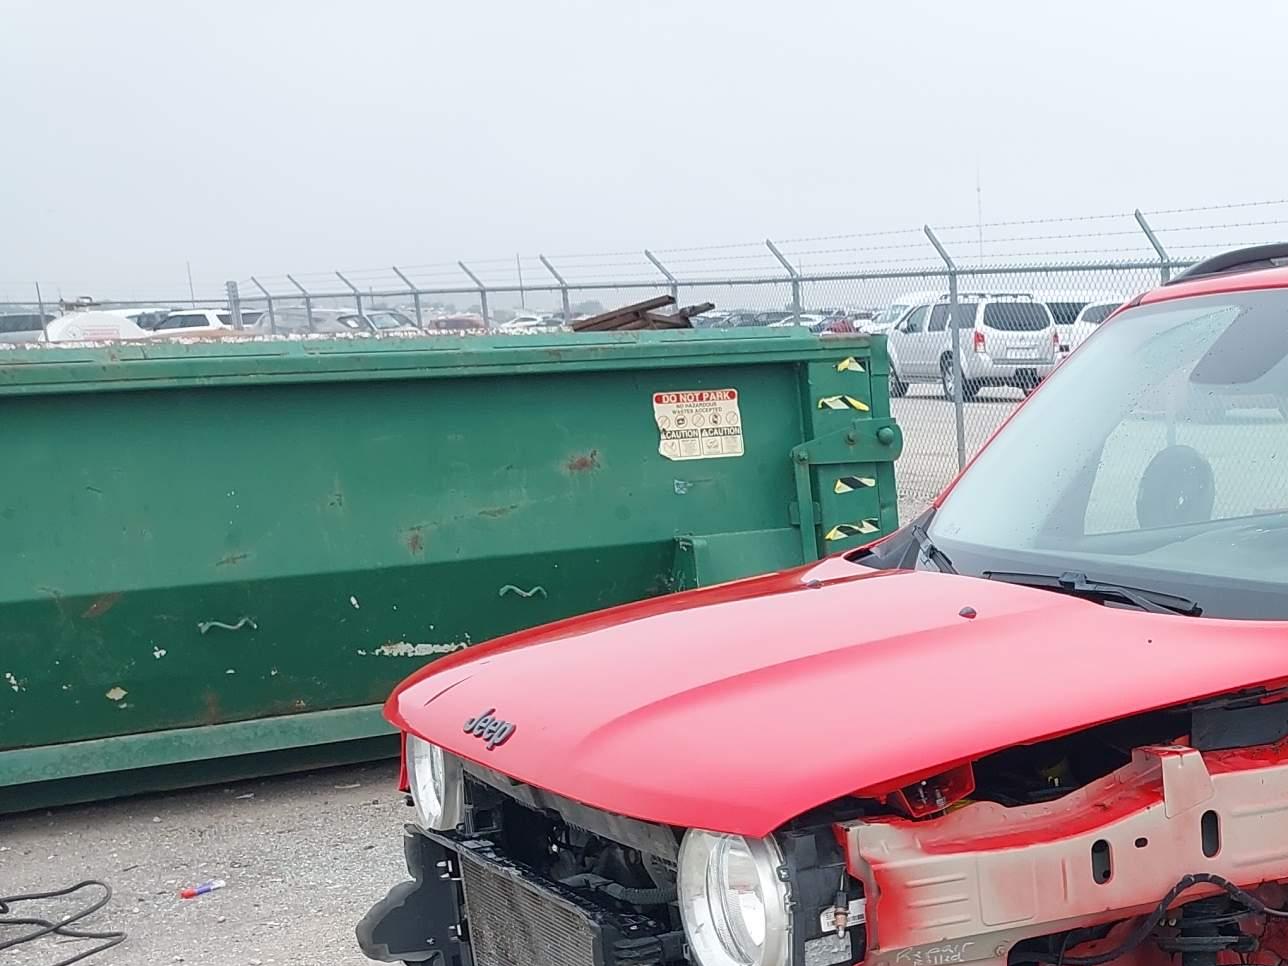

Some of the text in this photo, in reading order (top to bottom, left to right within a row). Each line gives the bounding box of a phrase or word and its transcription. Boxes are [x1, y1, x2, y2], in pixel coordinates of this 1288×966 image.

[662, 391, 730, 403] DO NOT PARK
[666, 430, 698, 439] CAUTION
[708, 427, 740, 436] CAUTION
[463, 708, 516, 751] Jeep
